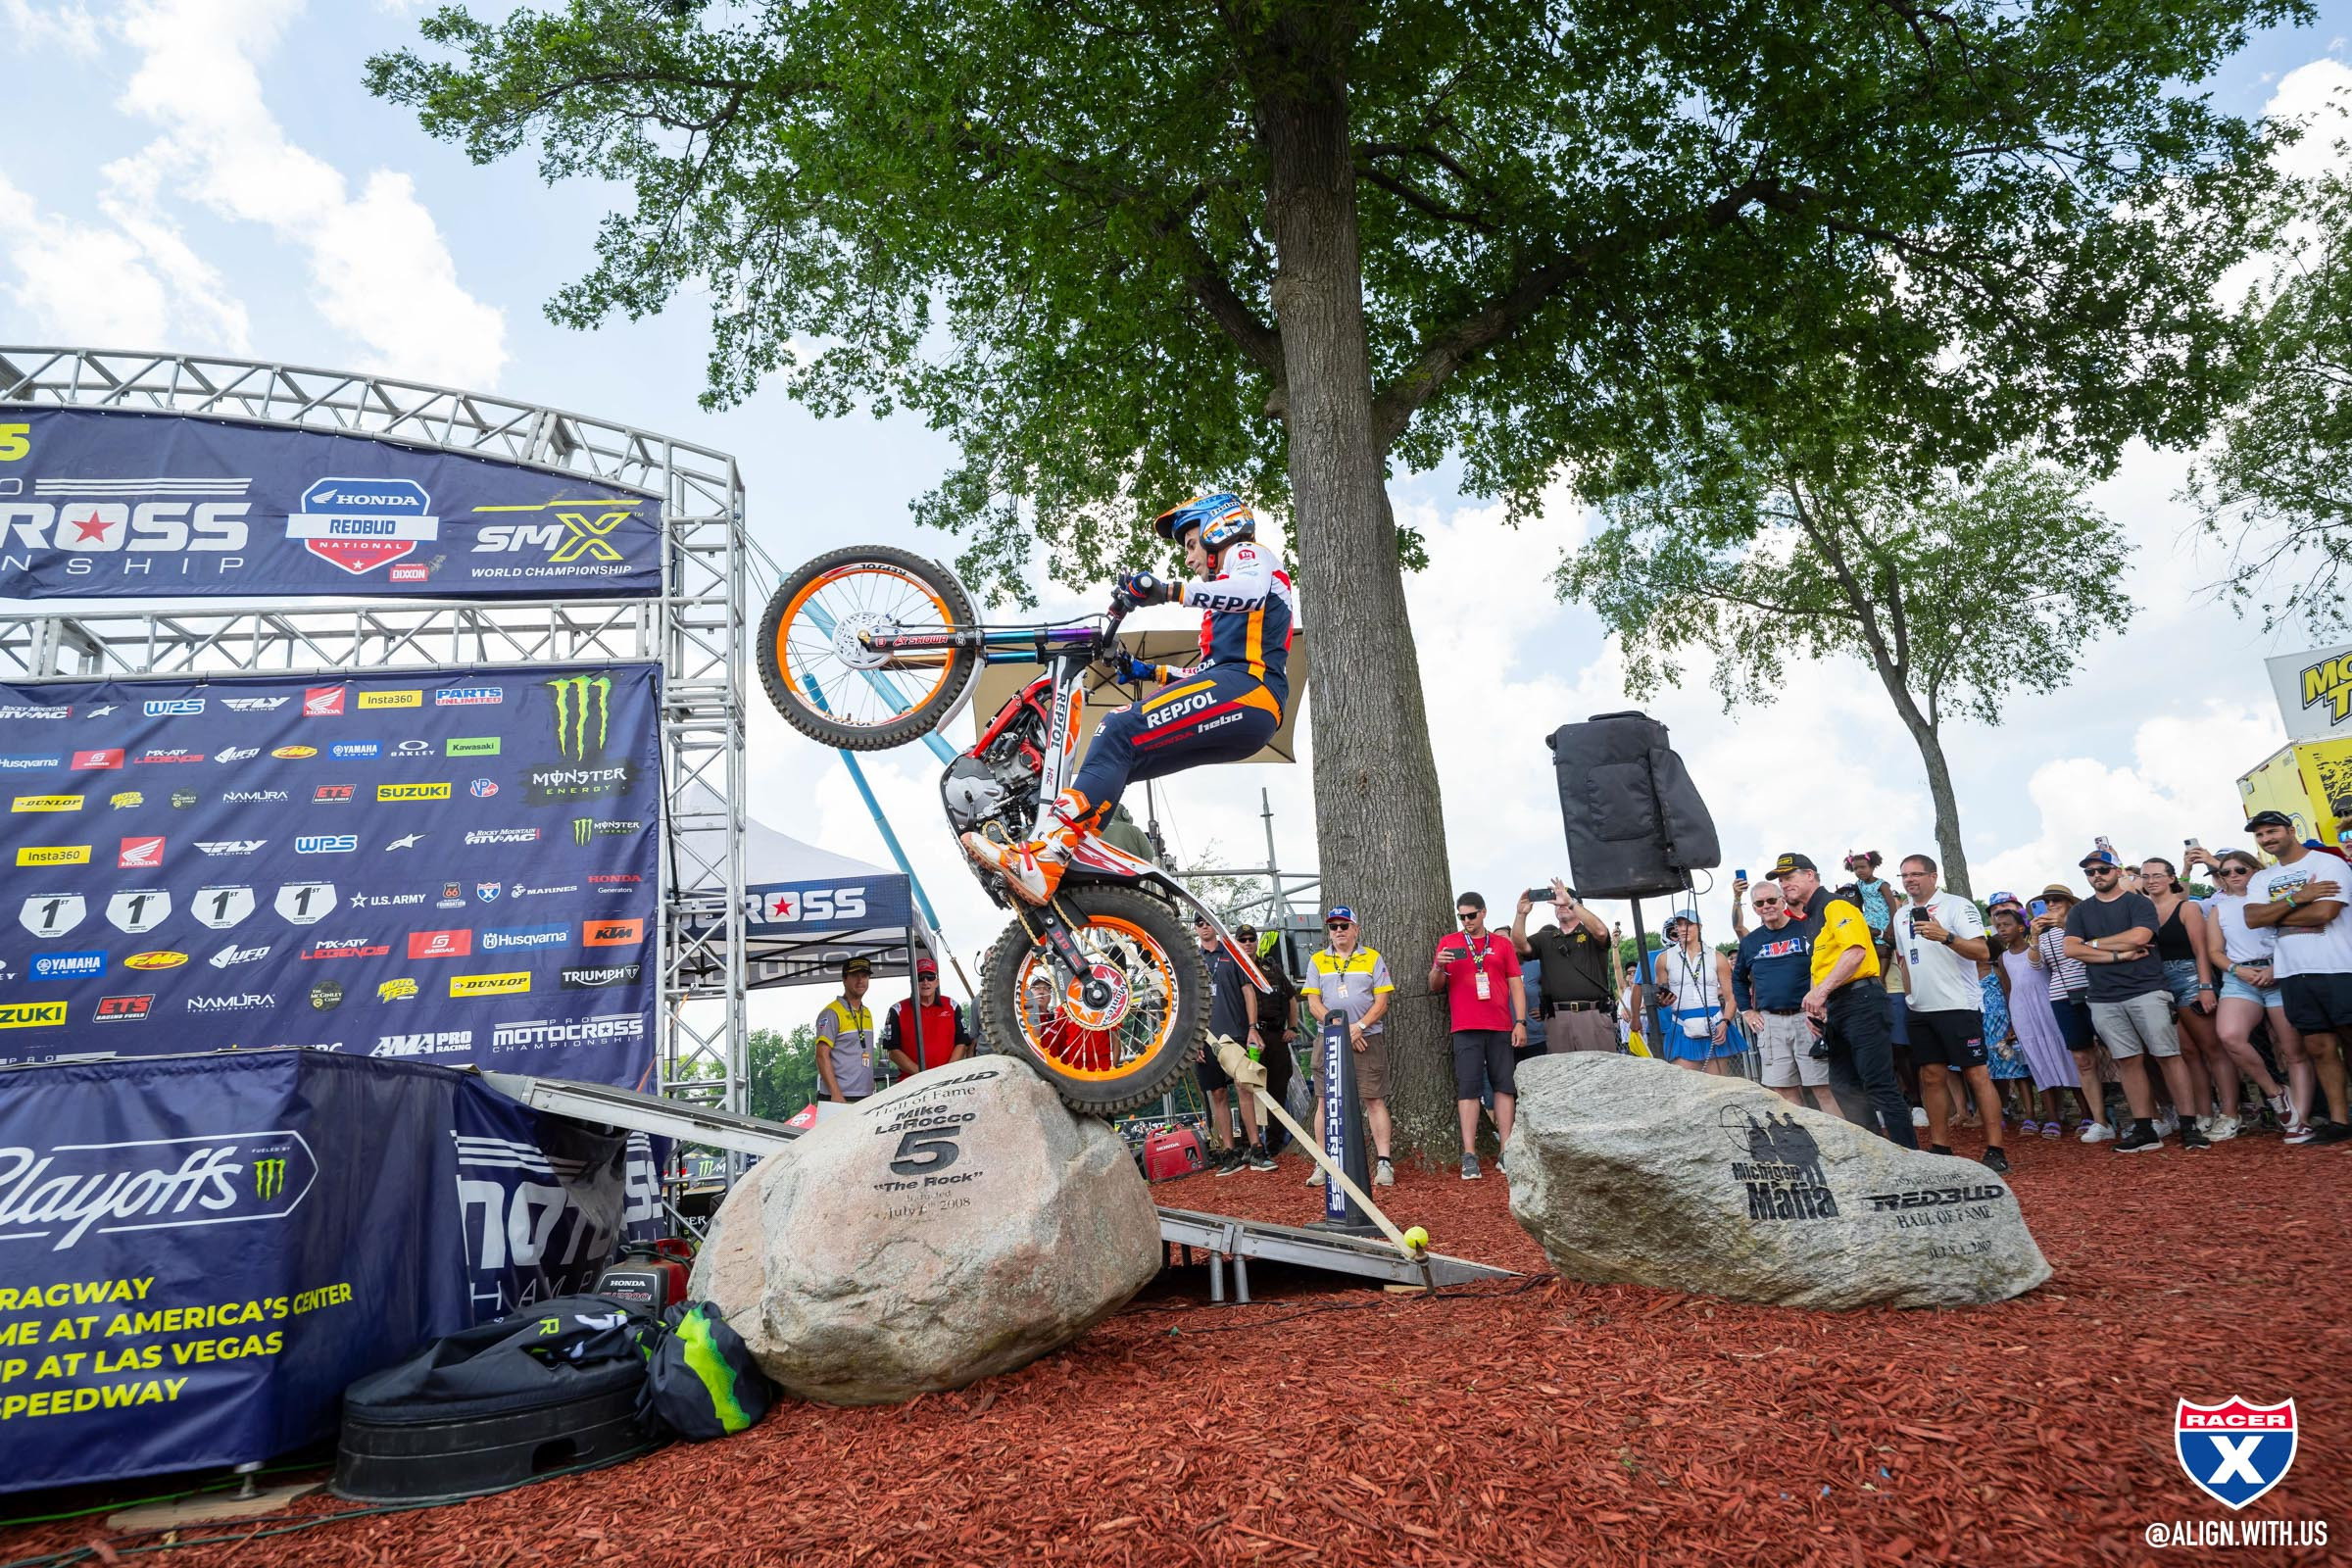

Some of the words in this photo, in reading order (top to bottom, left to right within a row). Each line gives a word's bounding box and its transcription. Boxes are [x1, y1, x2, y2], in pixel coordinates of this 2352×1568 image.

[336, 494, 419, 506] HONDA
[329, 519, 396, 535] REDBUD
[470, 512, 631, 563] SMX
[392, 569, 425, 579] DIXXON
[471, 567, 522, 577] WORLD
[524, 564, 632, 577] CHAMPIONSHIP
[908, 635, 948, 644] SHOWA
[368, 695, 413, 705] Insta360
[437, 688, 502, 698] PARTS
[143, 699, 206, 716] WPS
[225, 697, 290, 709] FLY
[1147, 692, 1217, 729] REPSOL
[1052, 692, 1066, 748] REPSOL
[1199, 712, 1244, 733] hebo
[232, 748, 261, 758] UFO
[343, 744, 377, 755] YAMAHA
[453, 743, 494, 752] Kawasaki
[0, 758, 59, 768] Husqvarna
[532, 767, 627, 786] MONSTER
[222, 790, 288, 801] NAMURA
[316, 786, 353, 798] ETS
[380, 786, 448, 798] SUZUKI
[546, 785, 612, 795] ENERGY
[26, 799, 81, 808] DUNLOP
[594, 820, 640, 829] MONSTER
[199, 840, 268, 853] FLY
[295, 835, 358, 854] WPS
[28, 851, 80, 861] Insta360
[588, 874, 642, 883] HONDA
[445, 888, 459, 897] 66
[527, 885, 577, 895] MARINES
[371, 896, 391, 906] U.S.
[393, 894, 426, 905] ARMY
[499, 932, 567, 947] Husqvarna
[595, 926, 633, 940] KTM
[316, 939, 368, 949] MX-ATV
[1754, 938, 1802, 958] AMA
[230, 946, 271, 961] UFO
[301, 946, 390, 959] LEGENDS
[52, 956, 100, 970] YAMAHA
[563, 967, 624, 983] TRIUMPH
[377, 978, 416, 997] MOTO
[466, 978, 527, 989] DUNLOP
[187, 993, 275, 1009] NAMURA
[383, 986, 418, 1004] TEES
[100, 996, 152, 1014] ETS
[0, 1006, 62, 1023] ZUKI
[550, 1016, 589, 1025] PRO
[493, 1019, 643, 1047] MOTOCROSS
[369, 1033, 435, 1056] AMA
[437, 1031, 471, 1045] PRO
[436, 1044, 471, 1053] RACING
[493, 1035, 644, 1053] CHAMPIONSHIP
[912, 1096, 927, 1105] of
[933, 1086, 975, 1100] Fame
[896, 1104, 948, 1121] Mike
[875, 1112, 976, 1135] LaRocco
[890, 1126, 961, 1176] 5
[1156, 1142, 1180, 1152] HONDA
[1732, 1161, 1800, 1182] Michigan
[889, 1206, 914, 1219] July
[941, 1198, 970, 1210] 2008
[1746, 1183, 1838, 1220] Mafia
[1897, 1213, 1935, 1228] HALL
[1937, 1210, 1953, 1224] OF
[1956, 1204, 1994, 1221] FAME
[1929, 1245, 1957, 1260] JULY
[48, 1316, 99, 1343] AT
[105, 1297, 289, 1338] AMERICA'S
[294, 1282, 353, 1315] CENTER
[35, 1352, 86, 1380] AT
[94, 1345, 163, 1374] LAS
[172, 1331, 283, 1365] VEGAS
